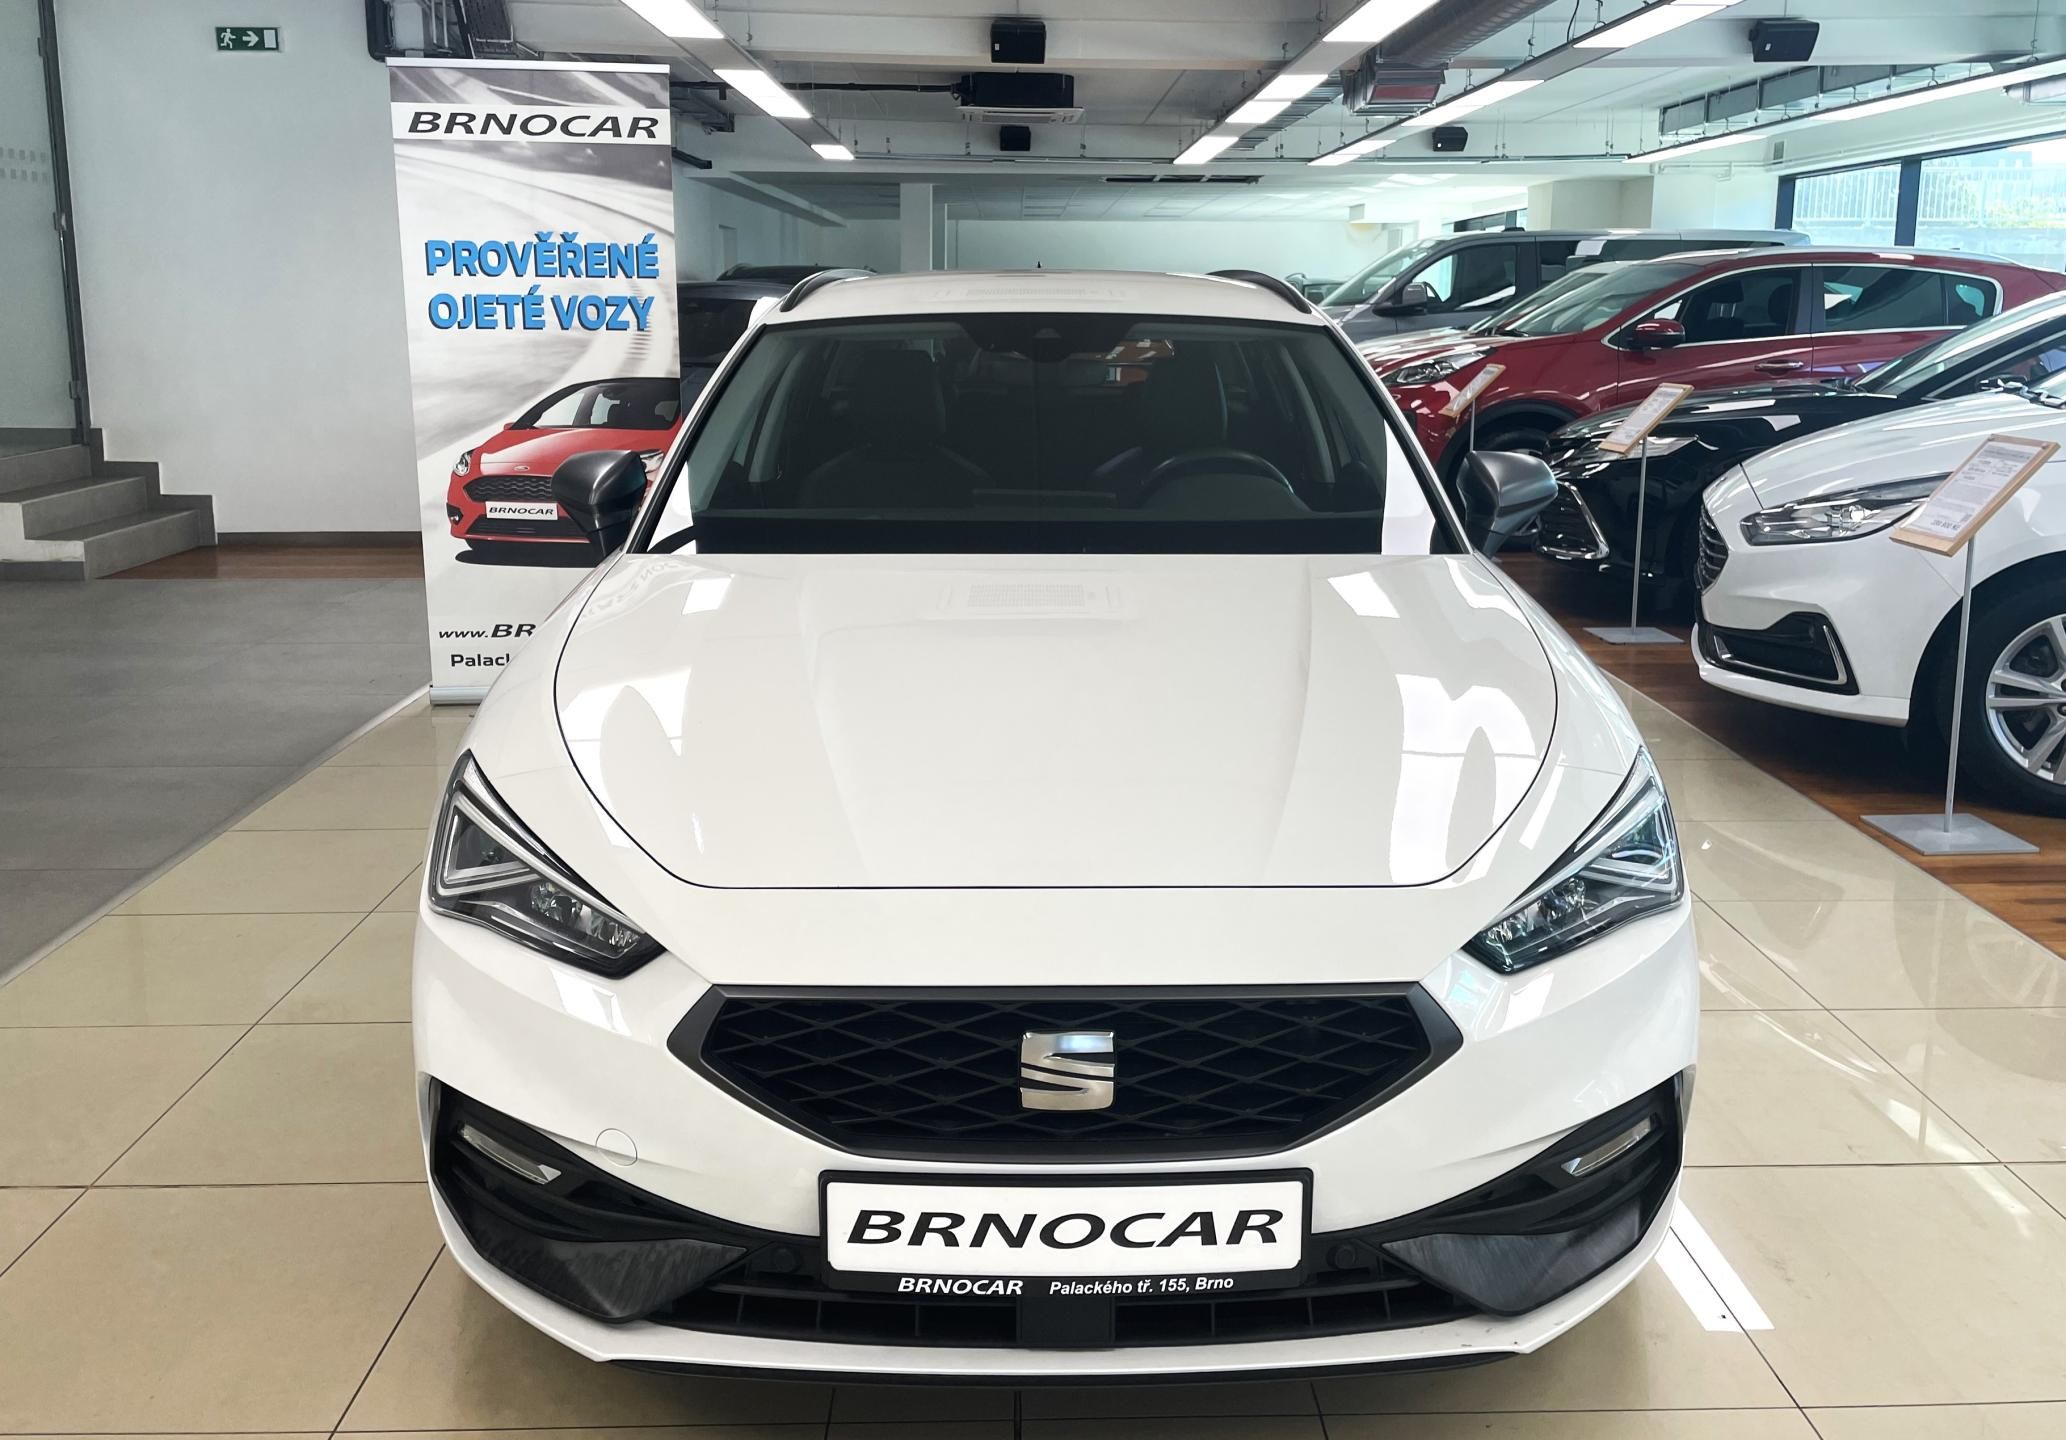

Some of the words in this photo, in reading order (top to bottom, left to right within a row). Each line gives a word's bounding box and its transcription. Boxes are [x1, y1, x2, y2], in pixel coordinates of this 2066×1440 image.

[407, 111, 660, 139] BRNOCAR
[425, 231, 660, 279] PROVĚŘENÉ
[428, 284, 546, 330] OJETÉ
[551, 294, 656, 331] VOZY
[488, 506, 555, 516] BRNOCAR
[846, 1208, 1285, 1250] BRNOCAR
[897, 1277, 1024, 1295] BRNOCAR
[1049, 1280, 1133, 1295] Palackého
[1137, 1279, 1153, 1293] tř.
[1159, 1277, 1190, 1293] 155,
[1195, 1276, 1234, 1291] Brno
